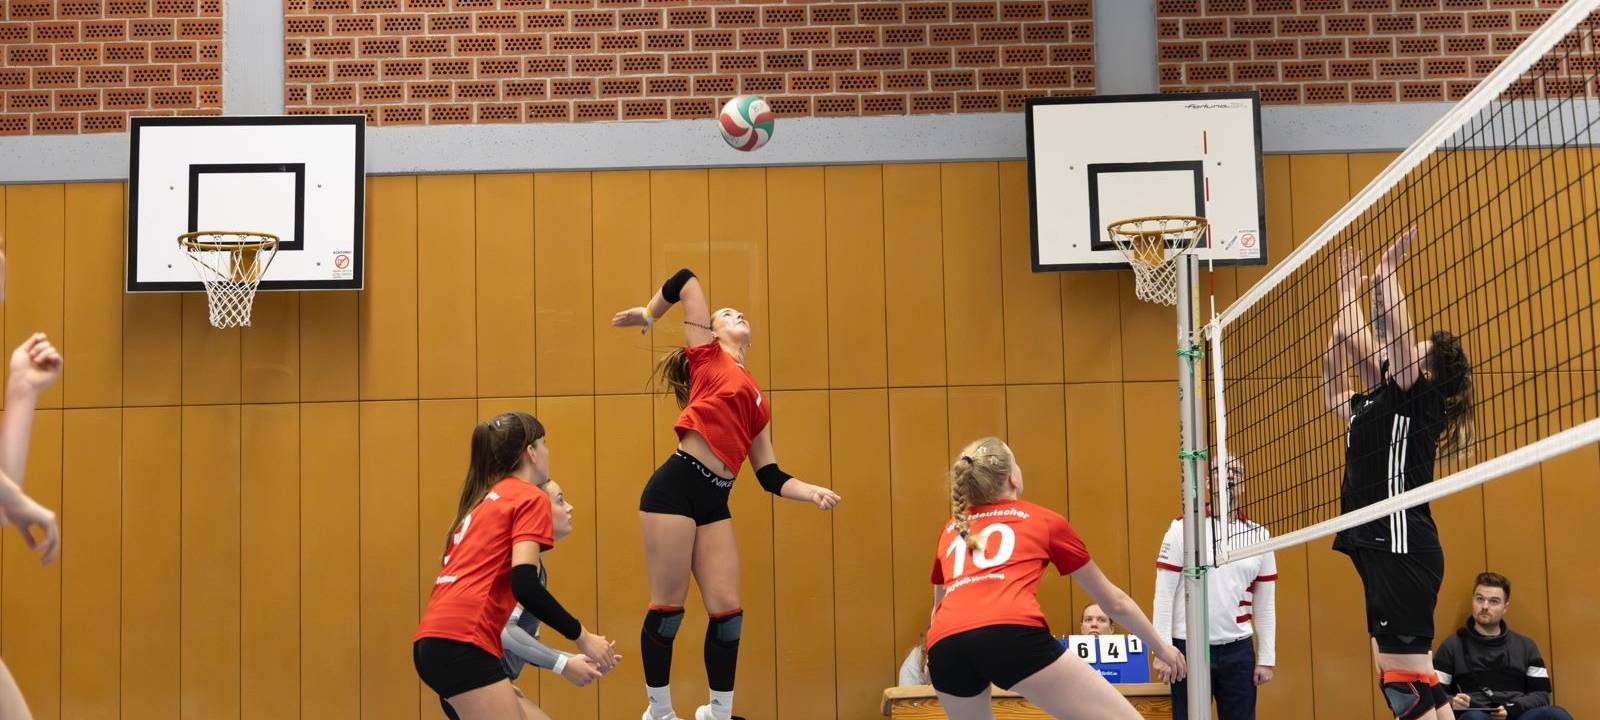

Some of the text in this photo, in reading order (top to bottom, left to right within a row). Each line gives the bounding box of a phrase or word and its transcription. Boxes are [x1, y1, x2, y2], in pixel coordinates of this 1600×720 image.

[946, 523, 1016, 580] 10
[1077, 638, 1138, 659] 6 4 1
